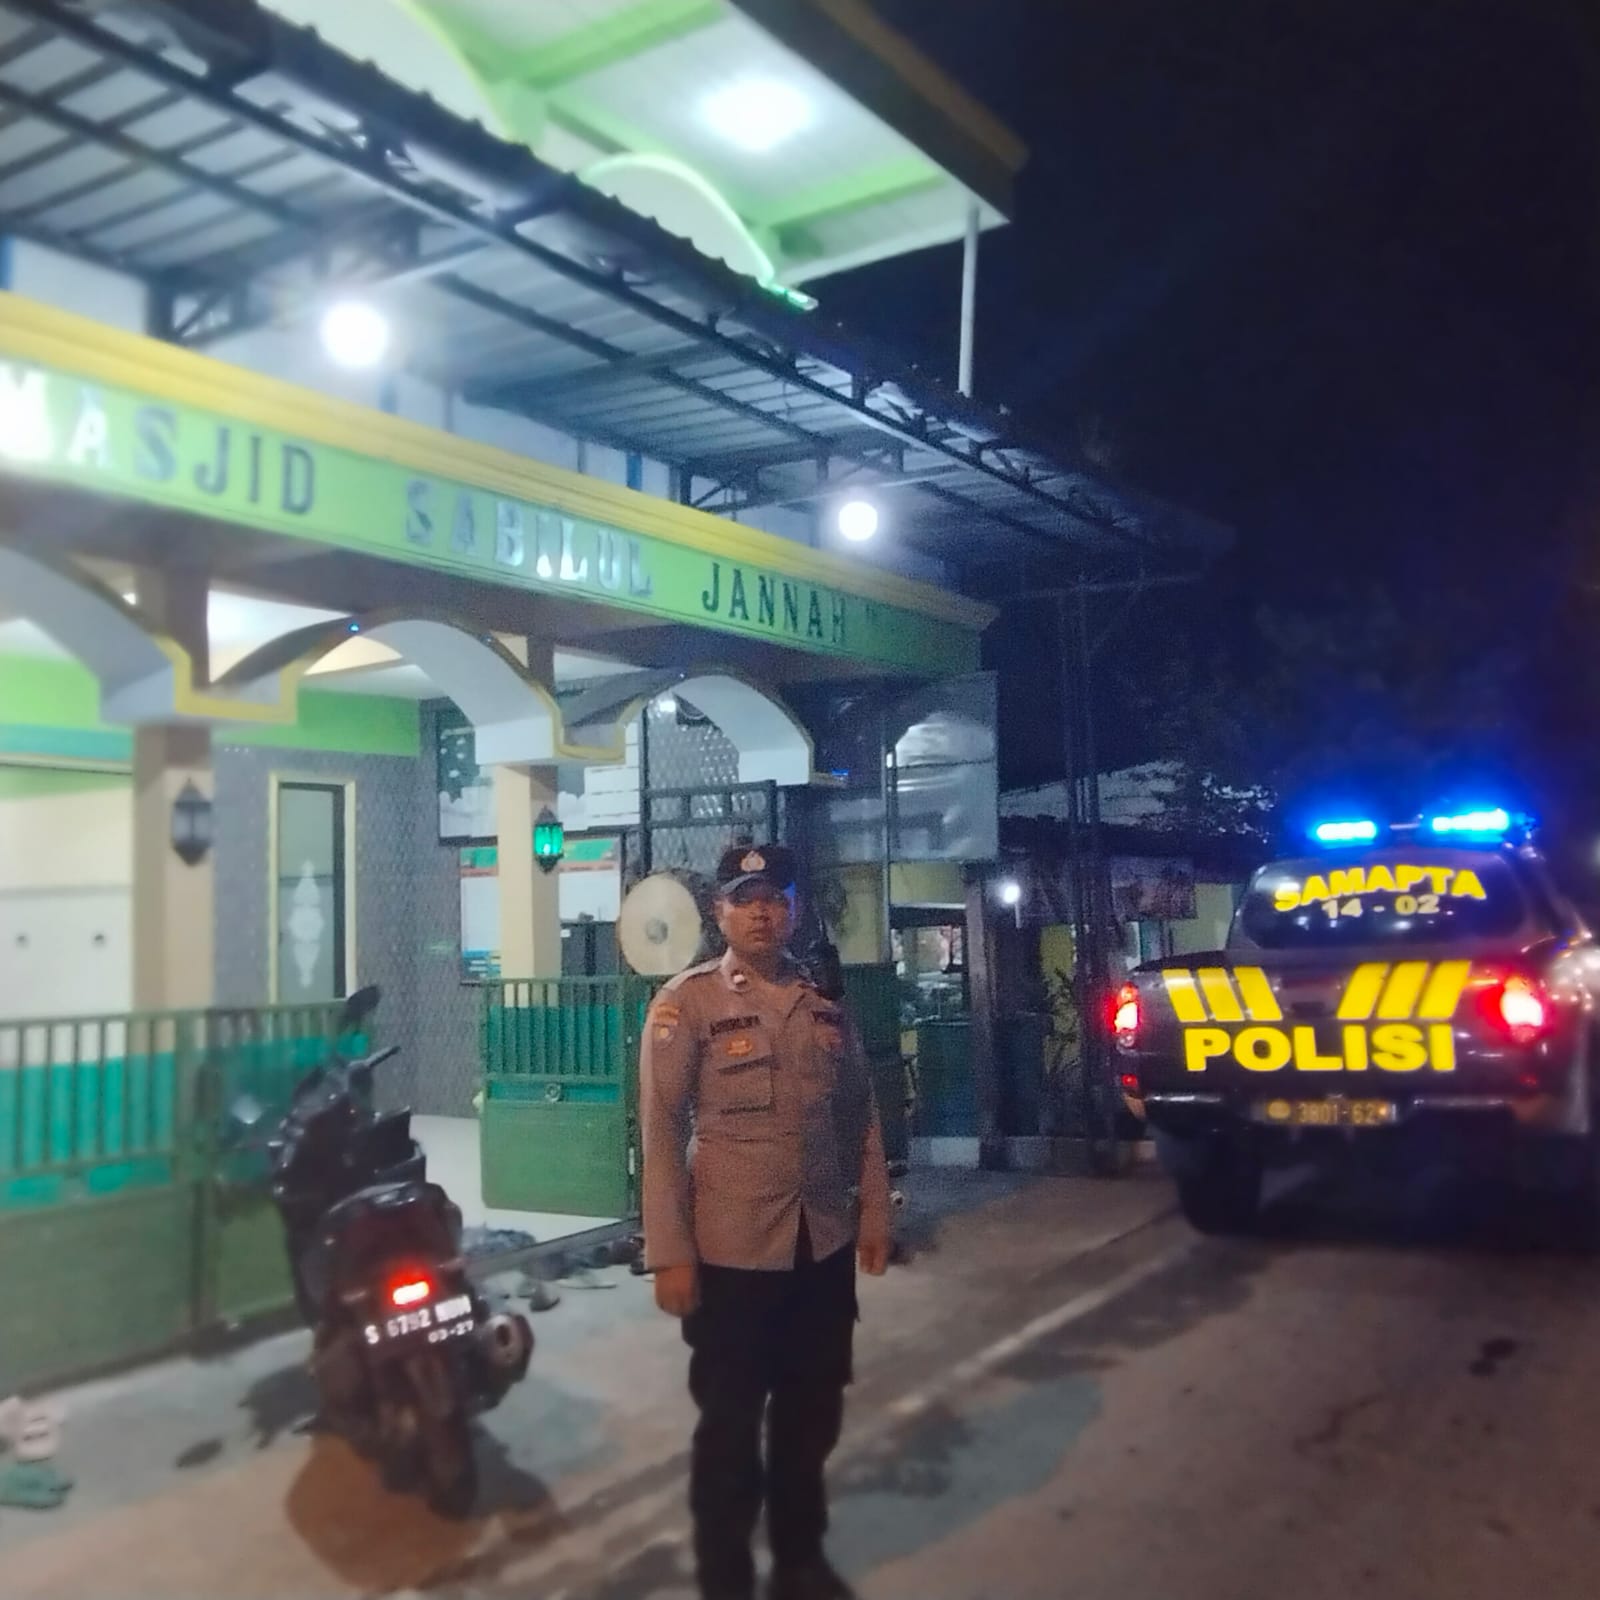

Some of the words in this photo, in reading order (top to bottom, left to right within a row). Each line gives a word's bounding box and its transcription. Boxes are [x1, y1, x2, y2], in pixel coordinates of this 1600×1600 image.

[0, 364, 317, 517] MASJID
[405, 478, 654, 598] SABILUL
[702, 561, 847, 644] JANNAH
[1274, 864, 1487, 912] SAMAPTA
[1321, 898, 1363, 919] 14
[1395, 894, 1440, 916] 02
[1185, 1023, 1456, 1072] POLISI
[364, 1324, 380, 1345] S
